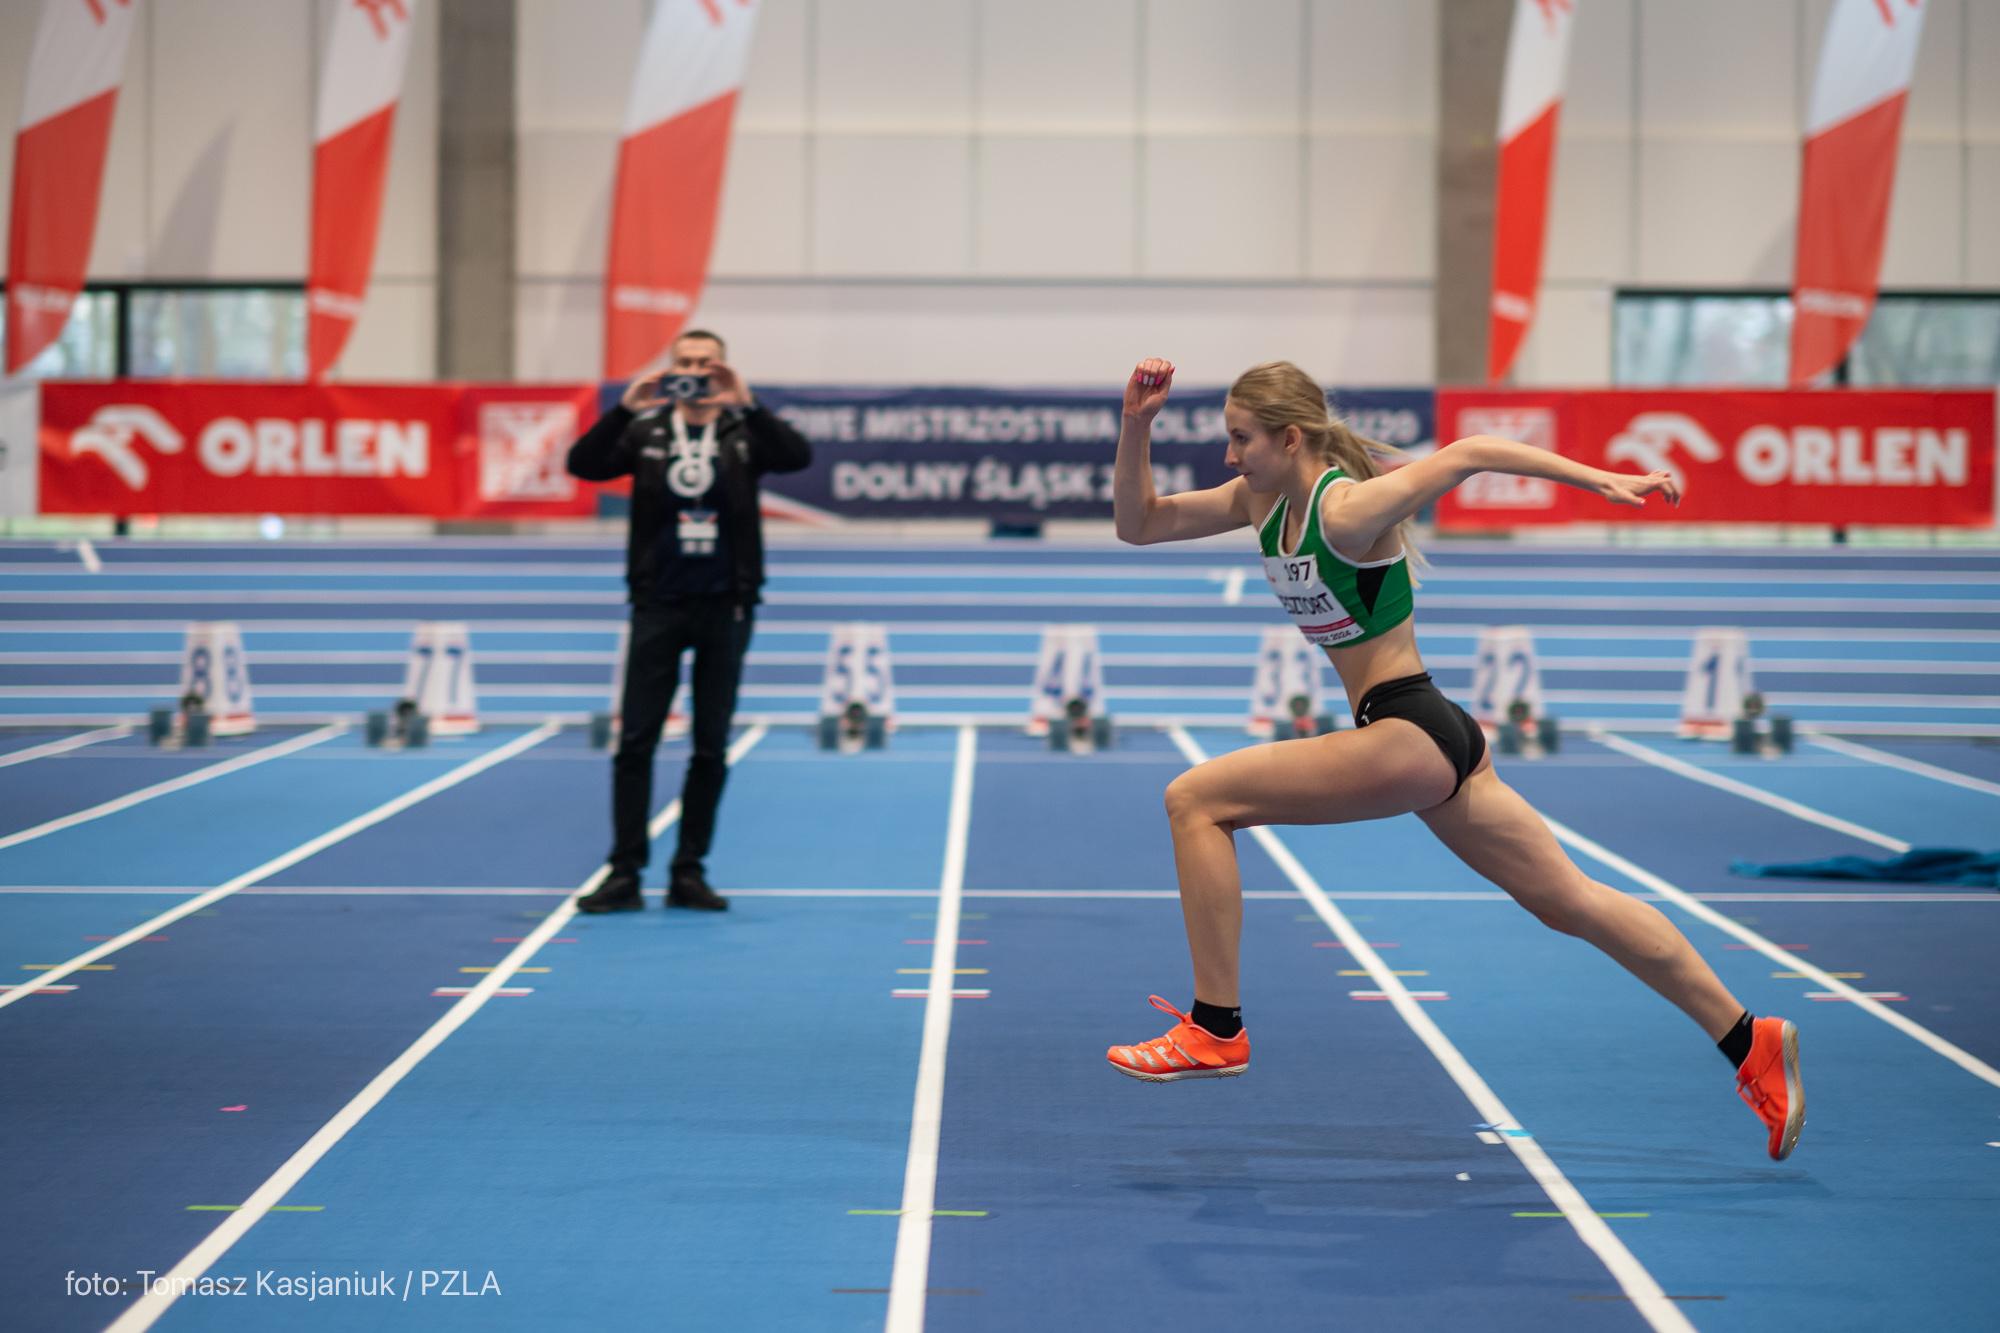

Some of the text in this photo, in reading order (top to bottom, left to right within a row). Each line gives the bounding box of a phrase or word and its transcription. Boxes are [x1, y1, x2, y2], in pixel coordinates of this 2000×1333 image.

[199, 417, 429, 477] ORLEN
[863, 406, 1117, 442] MISTRZOSTWA
[832, 462, 967, 499] DOLNY
[973, 456, 1099, 509] ŚLĄSK
[1735, 424, 1968, 486] ORLEN
[1284, 561, 1311, 582] 197
[445, 645, 463, 706] 7
[833, 646, 853, 703] 5
[866, 646, 886, 703] 5
[1699, 651, 1720, 710] 1
